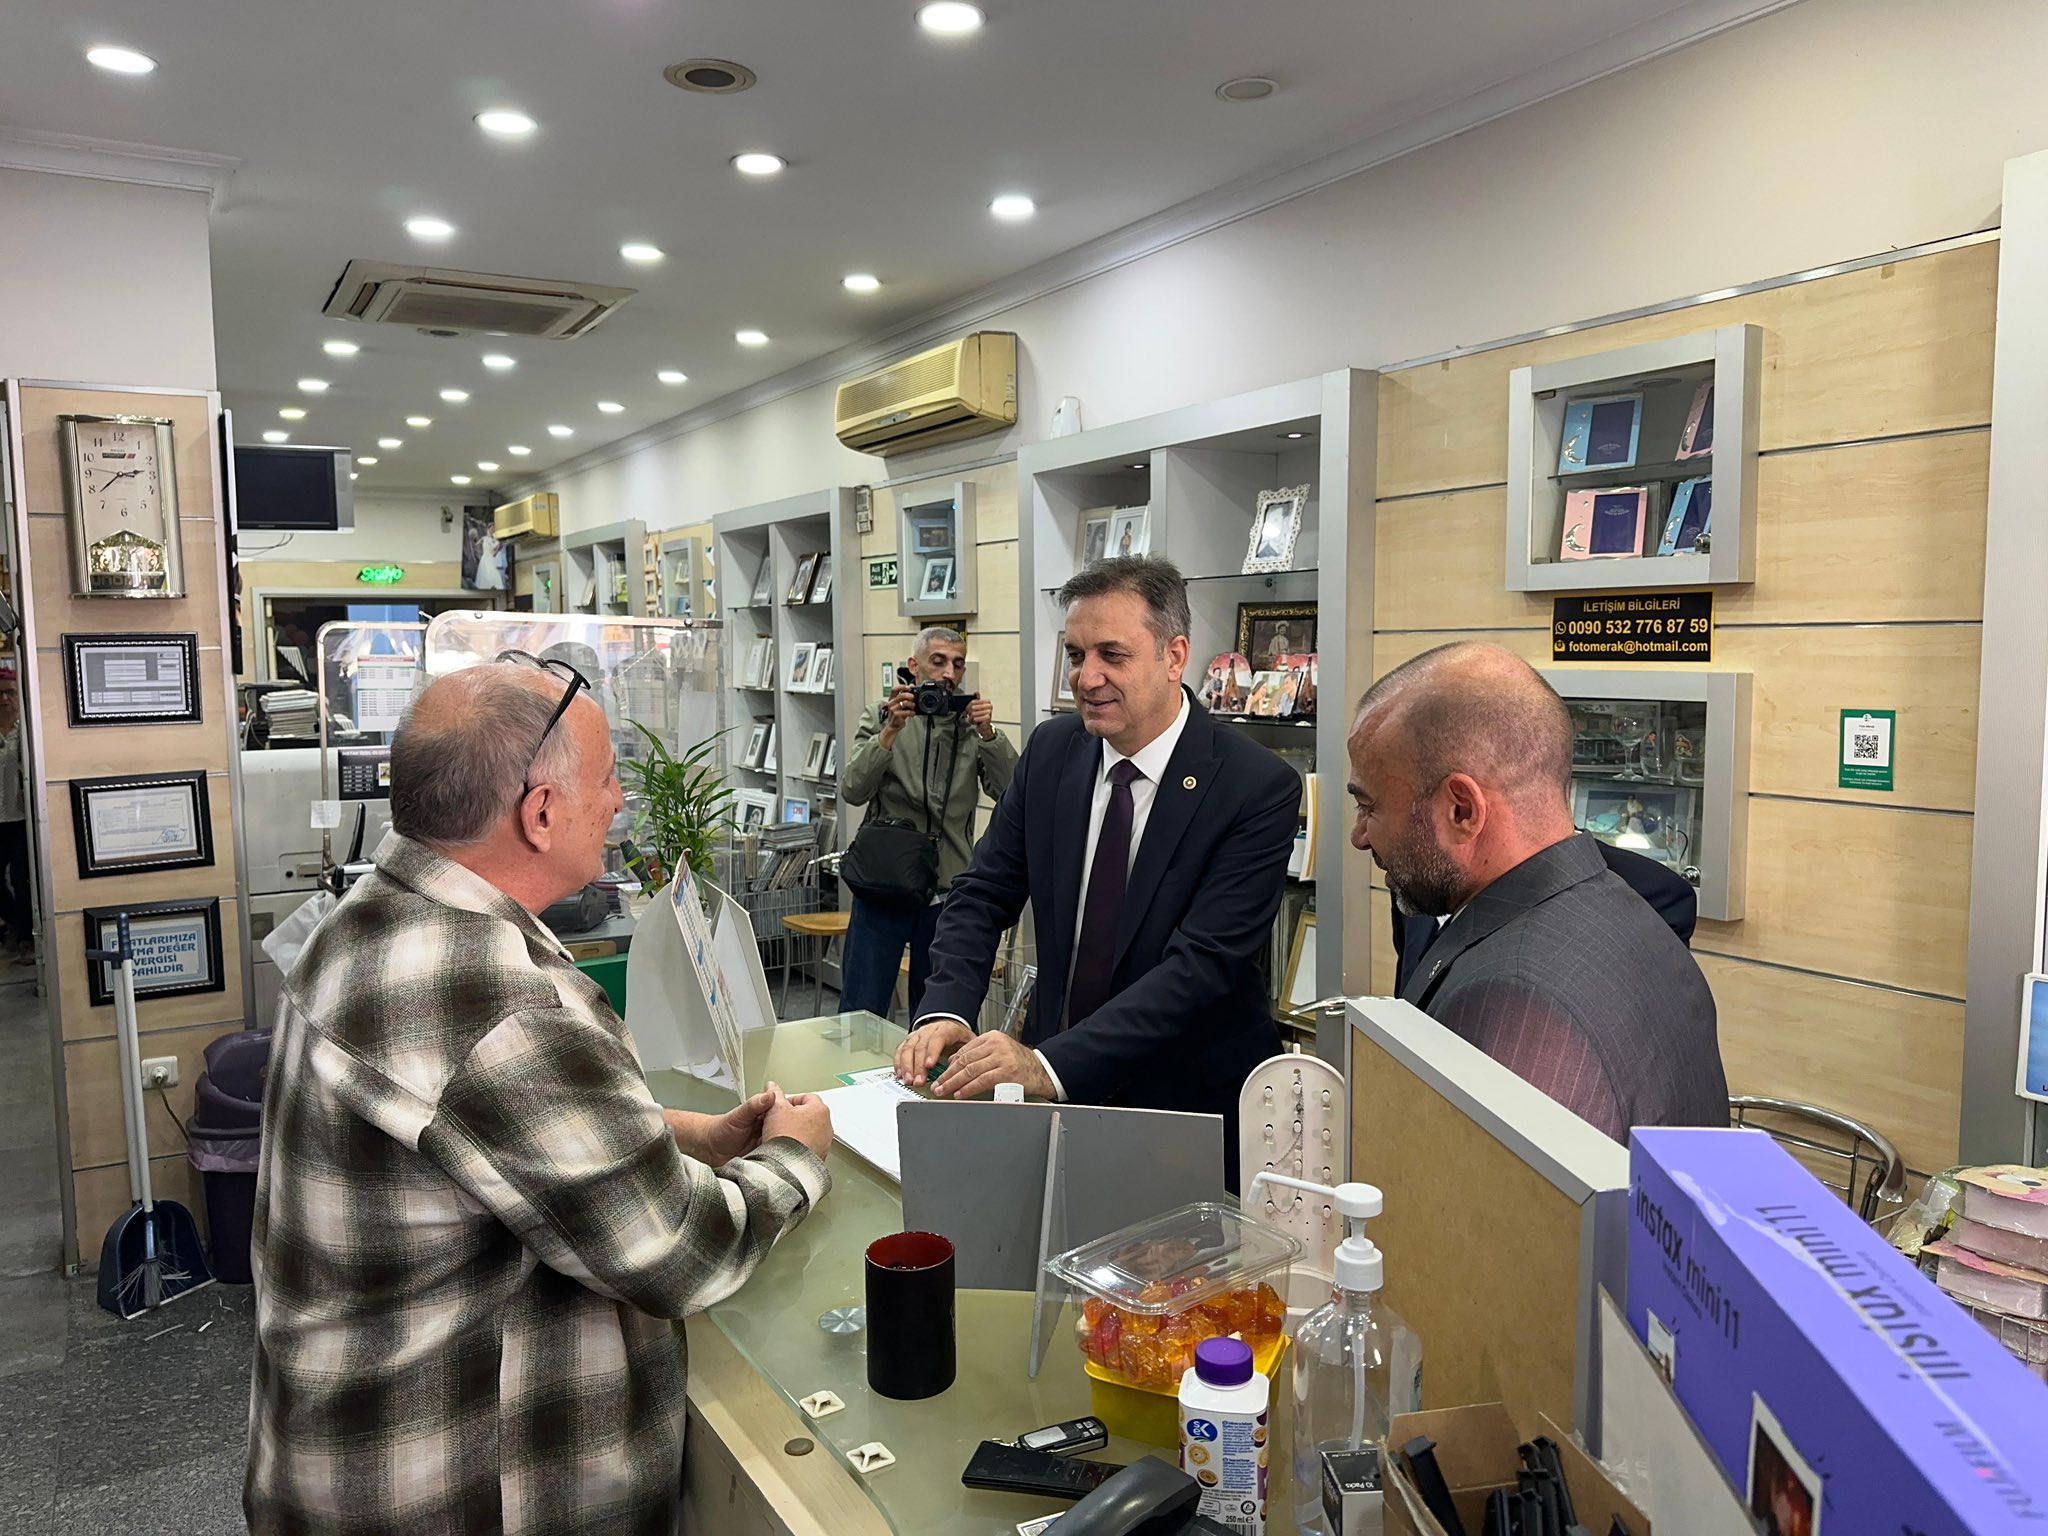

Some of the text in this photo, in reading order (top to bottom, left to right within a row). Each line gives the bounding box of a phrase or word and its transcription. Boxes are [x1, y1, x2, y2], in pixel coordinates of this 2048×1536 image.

[114, 432, 125, 442] 12
[94, 438, 103, 448] 11
[137, 441, 141, 450] 1
[83, 453, 95, 463] 10
[146, 456, 153, 466] 2
[85, 469, 92, 479] 9
[149, 471, 157, 480] 3
[88, 484, 96, 494] 8
[100, 500, 105, 509] 7
[140, 500, 147, 509] 5
[121, 508, 128, 517] 6
[1583, 598, 1680, 614] İLETİŞİM BİLGİLERİ
[1568, 618, 1709, 635] 0090 532 776 87 59
[1568, 640, 1709, 655] fotomerak@hotmail.com
[112, 932, 196, 950] FATLARIMIZA
[158, 941, 196, 954] DEĞER
[1636, 1174, 1684, 1271] instax
[1847, 1285, 1972, 1380] instax
